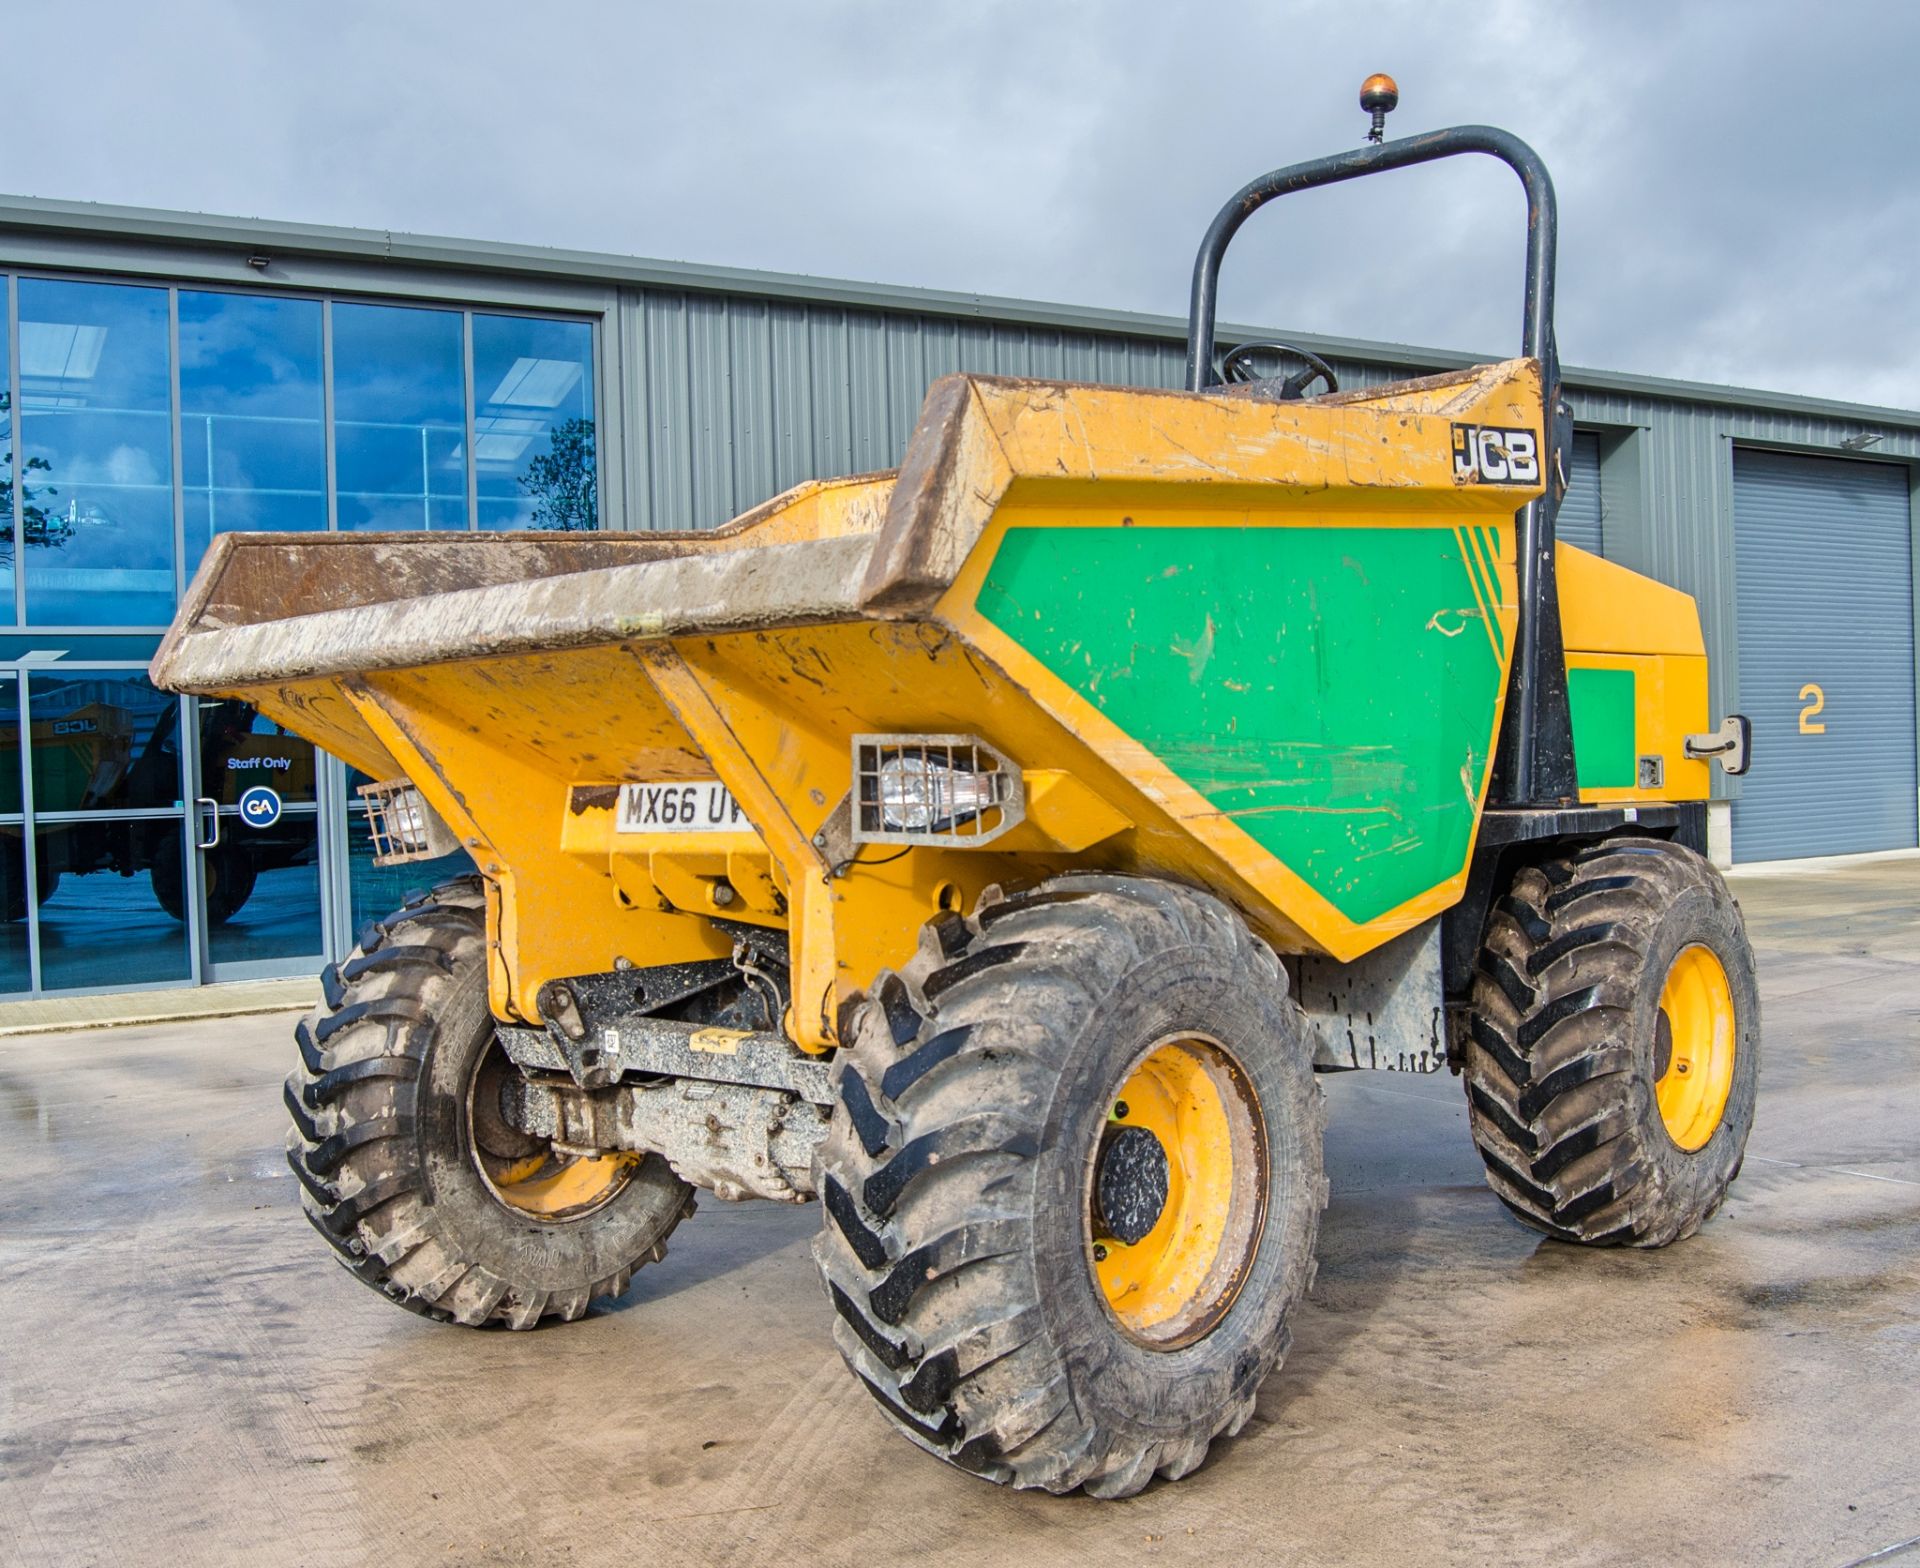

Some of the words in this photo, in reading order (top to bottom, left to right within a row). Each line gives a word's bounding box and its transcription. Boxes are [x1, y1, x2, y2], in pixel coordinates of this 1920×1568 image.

[1455, 429, 1538, 481] JCB
[1798, 683, 1826, 734] 2
[227, 757, 259, 770] Staff
[263, 756, 291, 771] Only
[246, 799, 273, 815] GA
[626, 787, 697, 824] MX66
